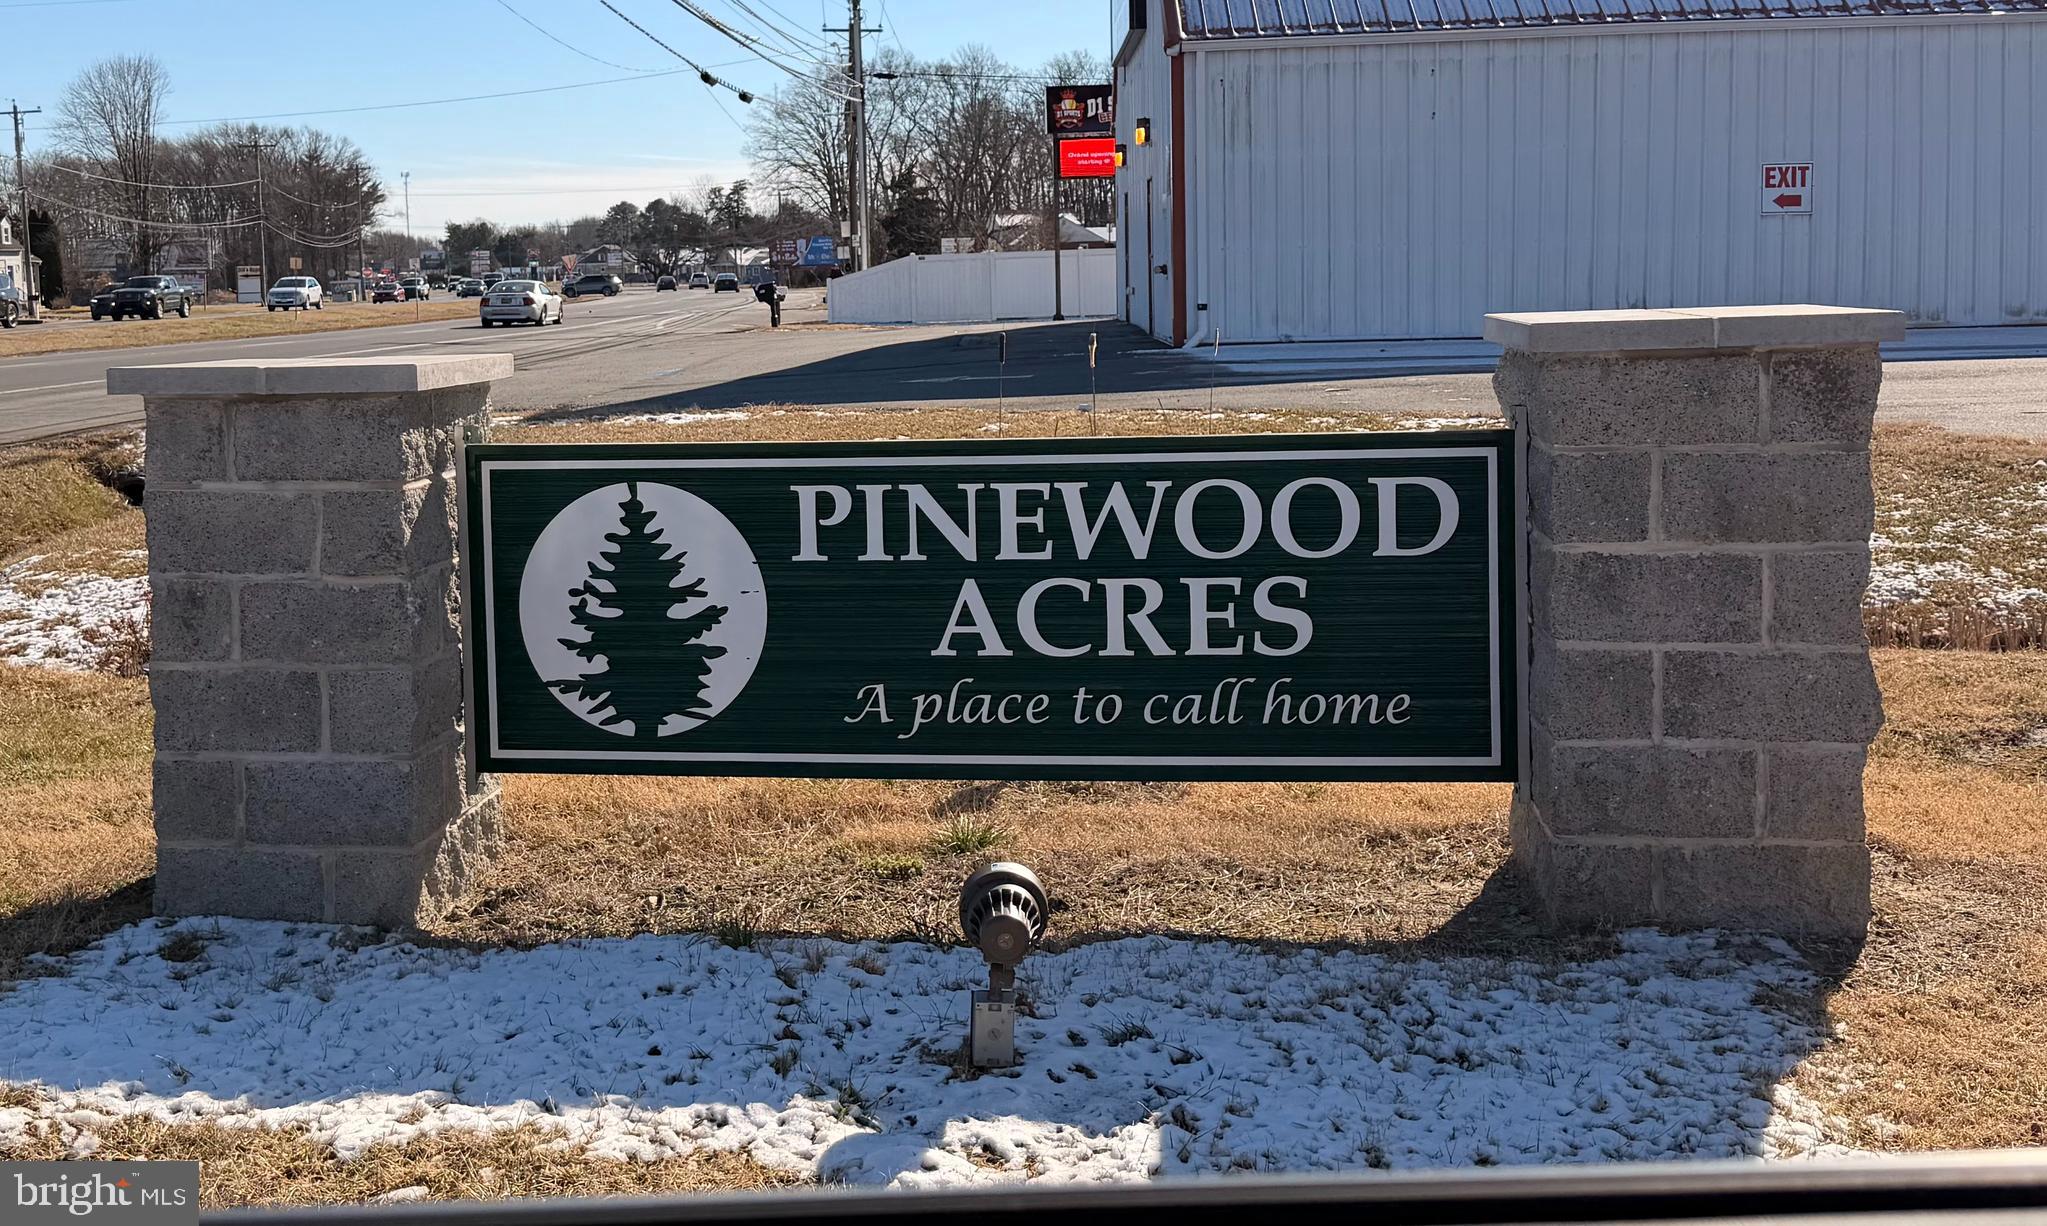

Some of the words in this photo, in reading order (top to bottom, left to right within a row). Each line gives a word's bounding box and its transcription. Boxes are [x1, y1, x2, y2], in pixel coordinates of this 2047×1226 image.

[1087, 97, 1103, 118] D1
[1765, 166, 1810, 188] EXIT
[791, 476, 1459, 562] PINEWOOD
[931, 575, 1313, 657] ACRES
[843, 683, 894, 724] A
[897, 678, 1049, 739] place
[1072, 687, 1123, 724] to
[1143, 677, 1256, 724] call
[1262, 677, 1411, 724] home
